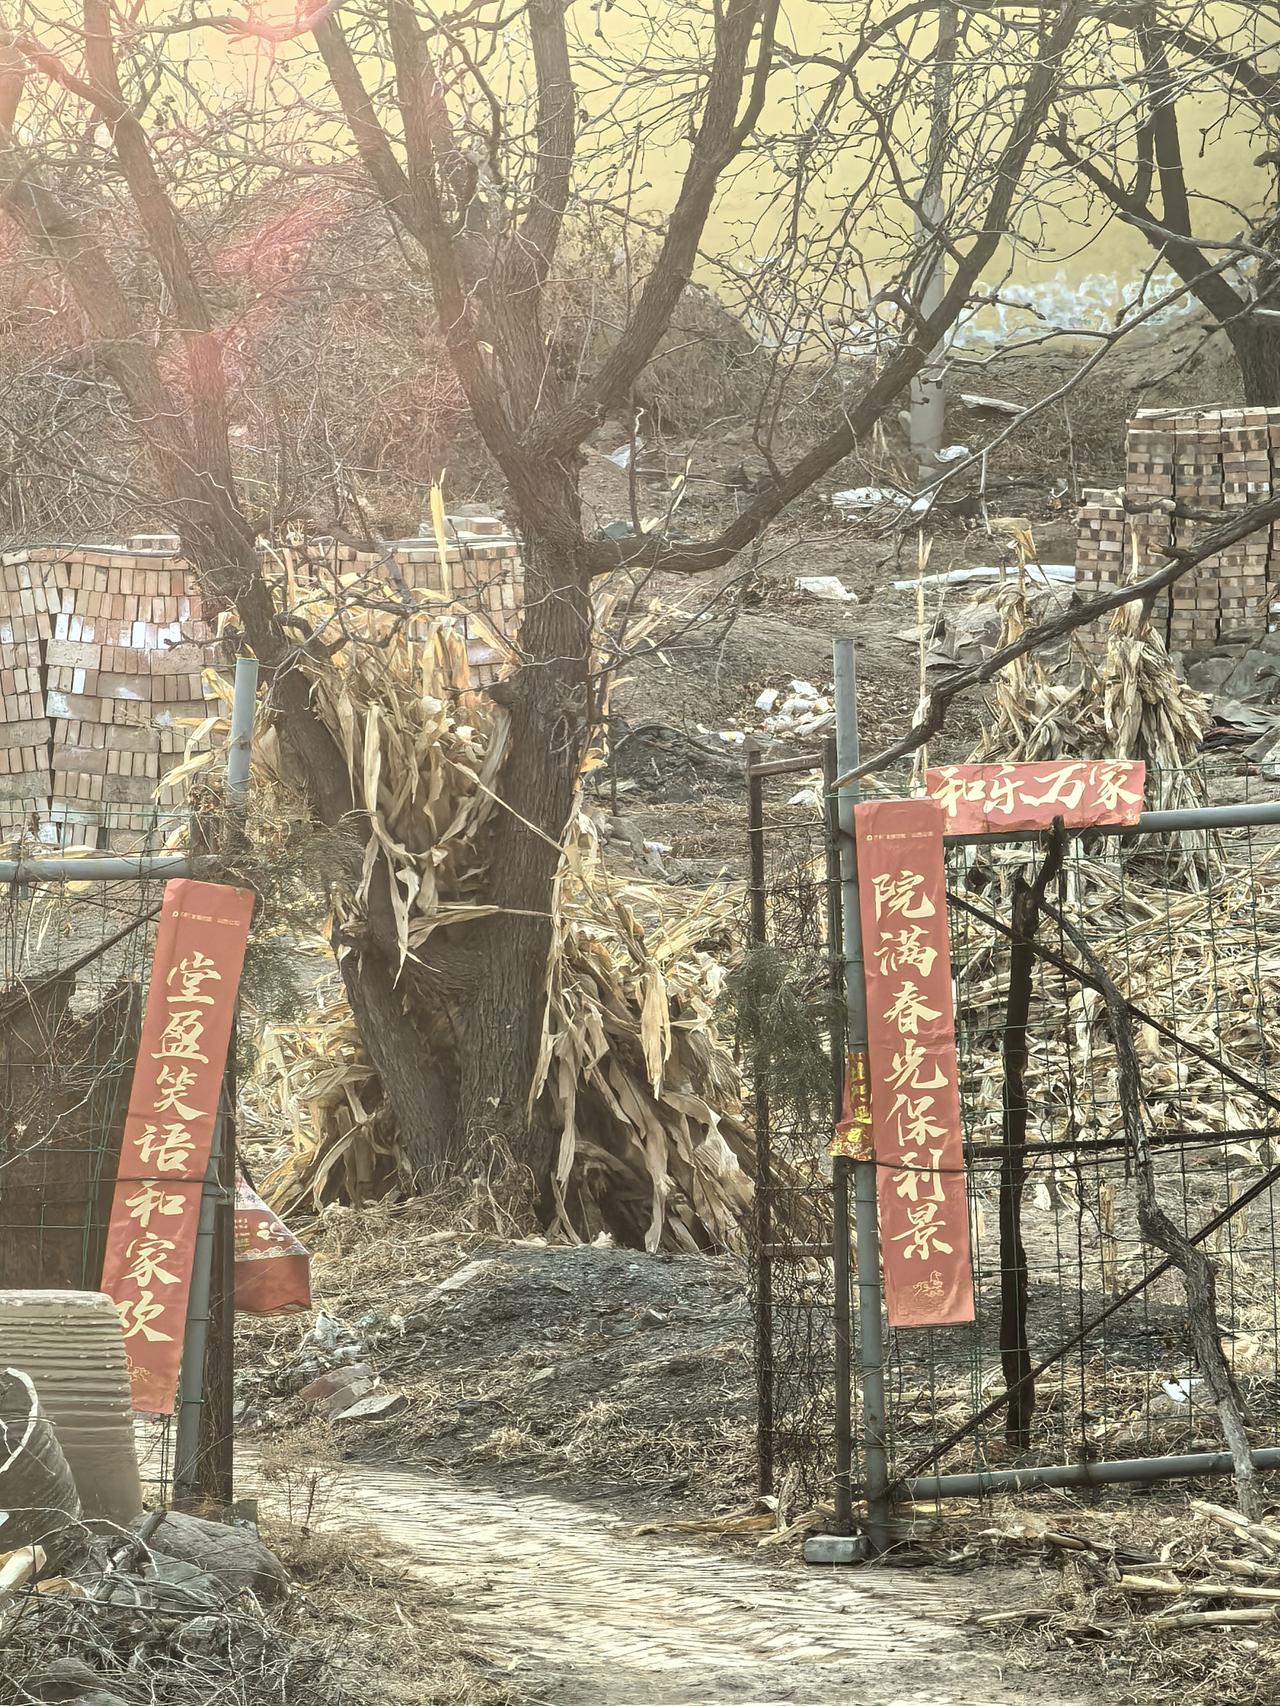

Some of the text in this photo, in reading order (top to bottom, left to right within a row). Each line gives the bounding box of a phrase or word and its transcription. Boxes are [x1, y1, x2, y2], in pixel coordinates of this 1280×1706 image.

[931, 761, 1142, 817] 和乐万家
[871, 870, 954, 1260] 院满春光保利景
